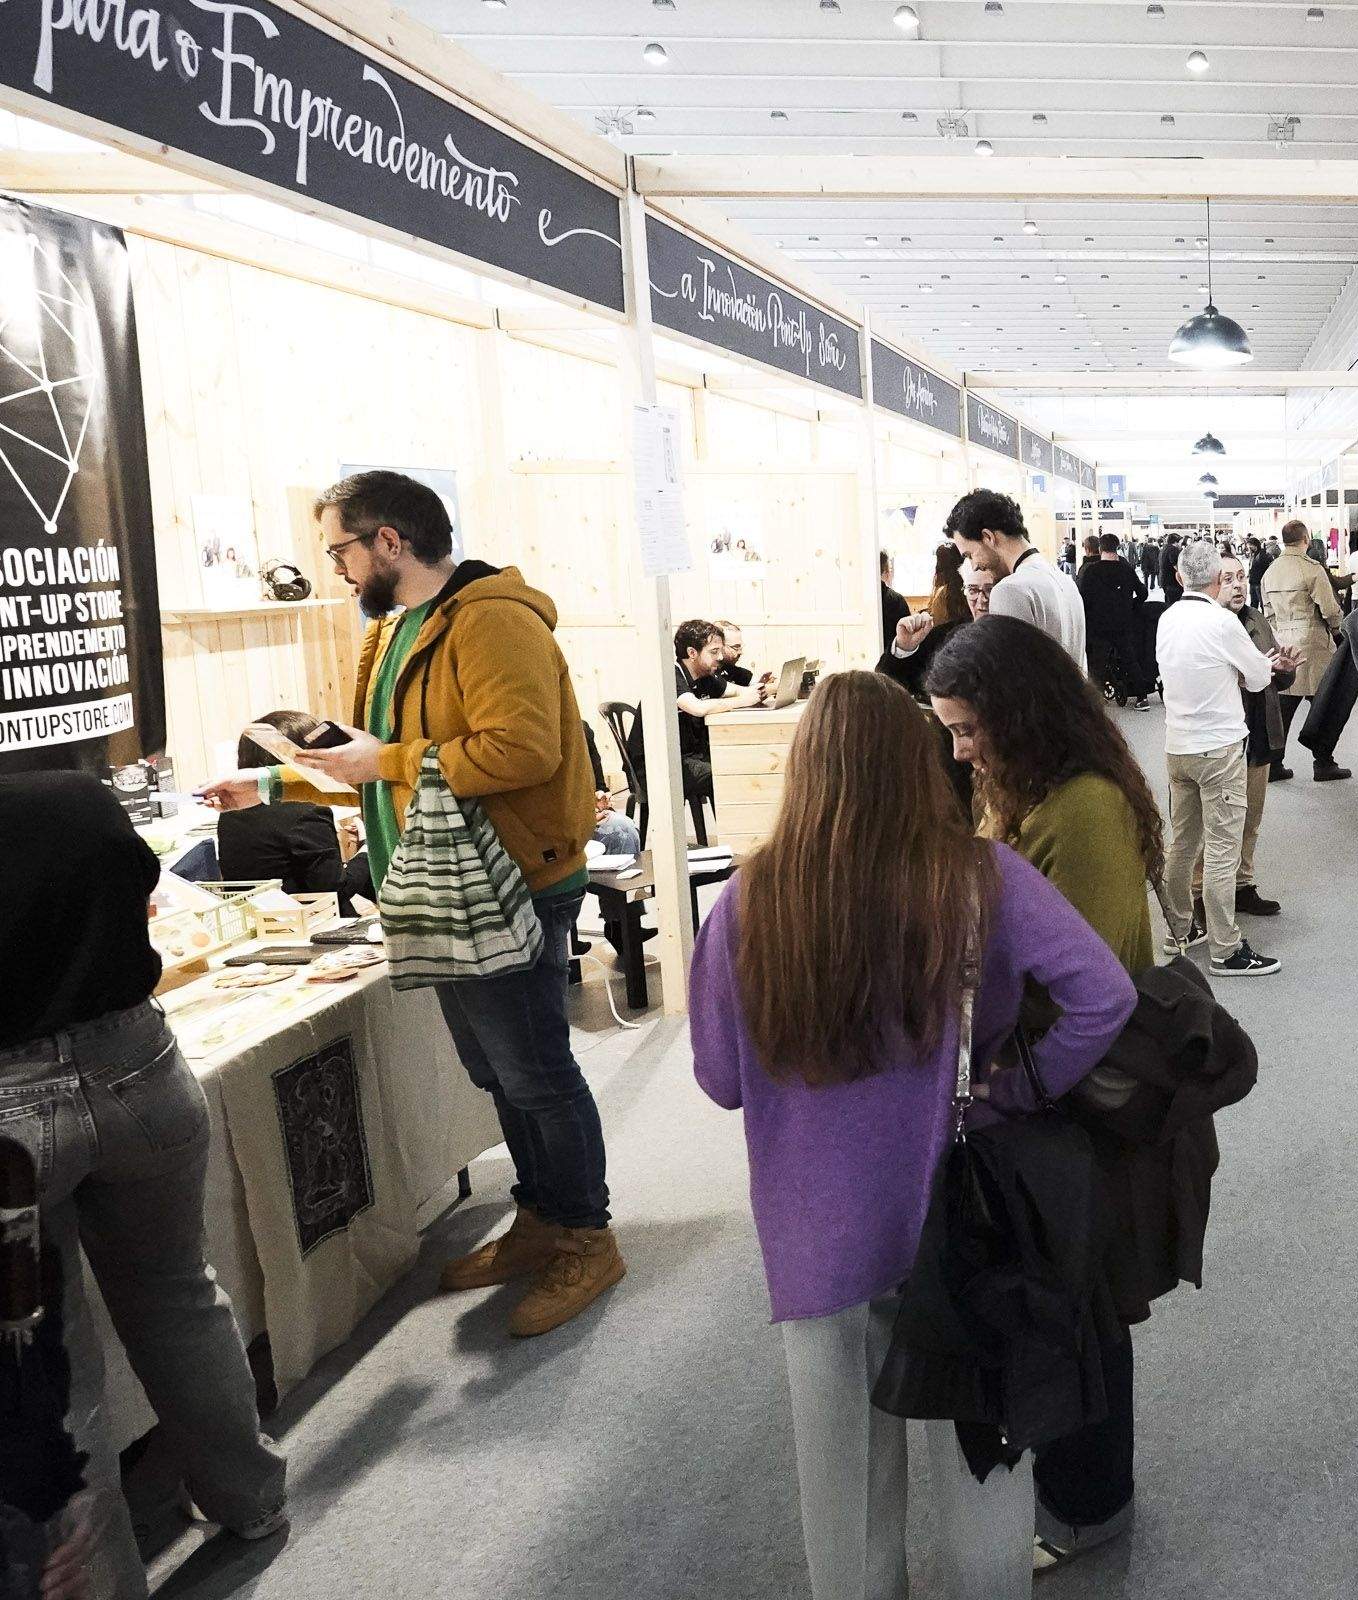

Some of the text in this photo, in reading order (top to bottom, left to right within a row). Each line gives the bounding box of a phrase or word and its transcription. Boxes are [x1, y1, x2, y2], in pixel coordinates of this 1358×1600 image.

[175, 29, 203, 78] o
[190, 0, 521, 222] Emprendemento
[680, 272, 697, 303] a
[0, 538, 121, 588] OCIACIÓN
[74, 589, 124, 623] STORE
[0, 624, 126, 663] PRENDEMENTO
[2, 649, 130, 701] INNOVACIÓN
